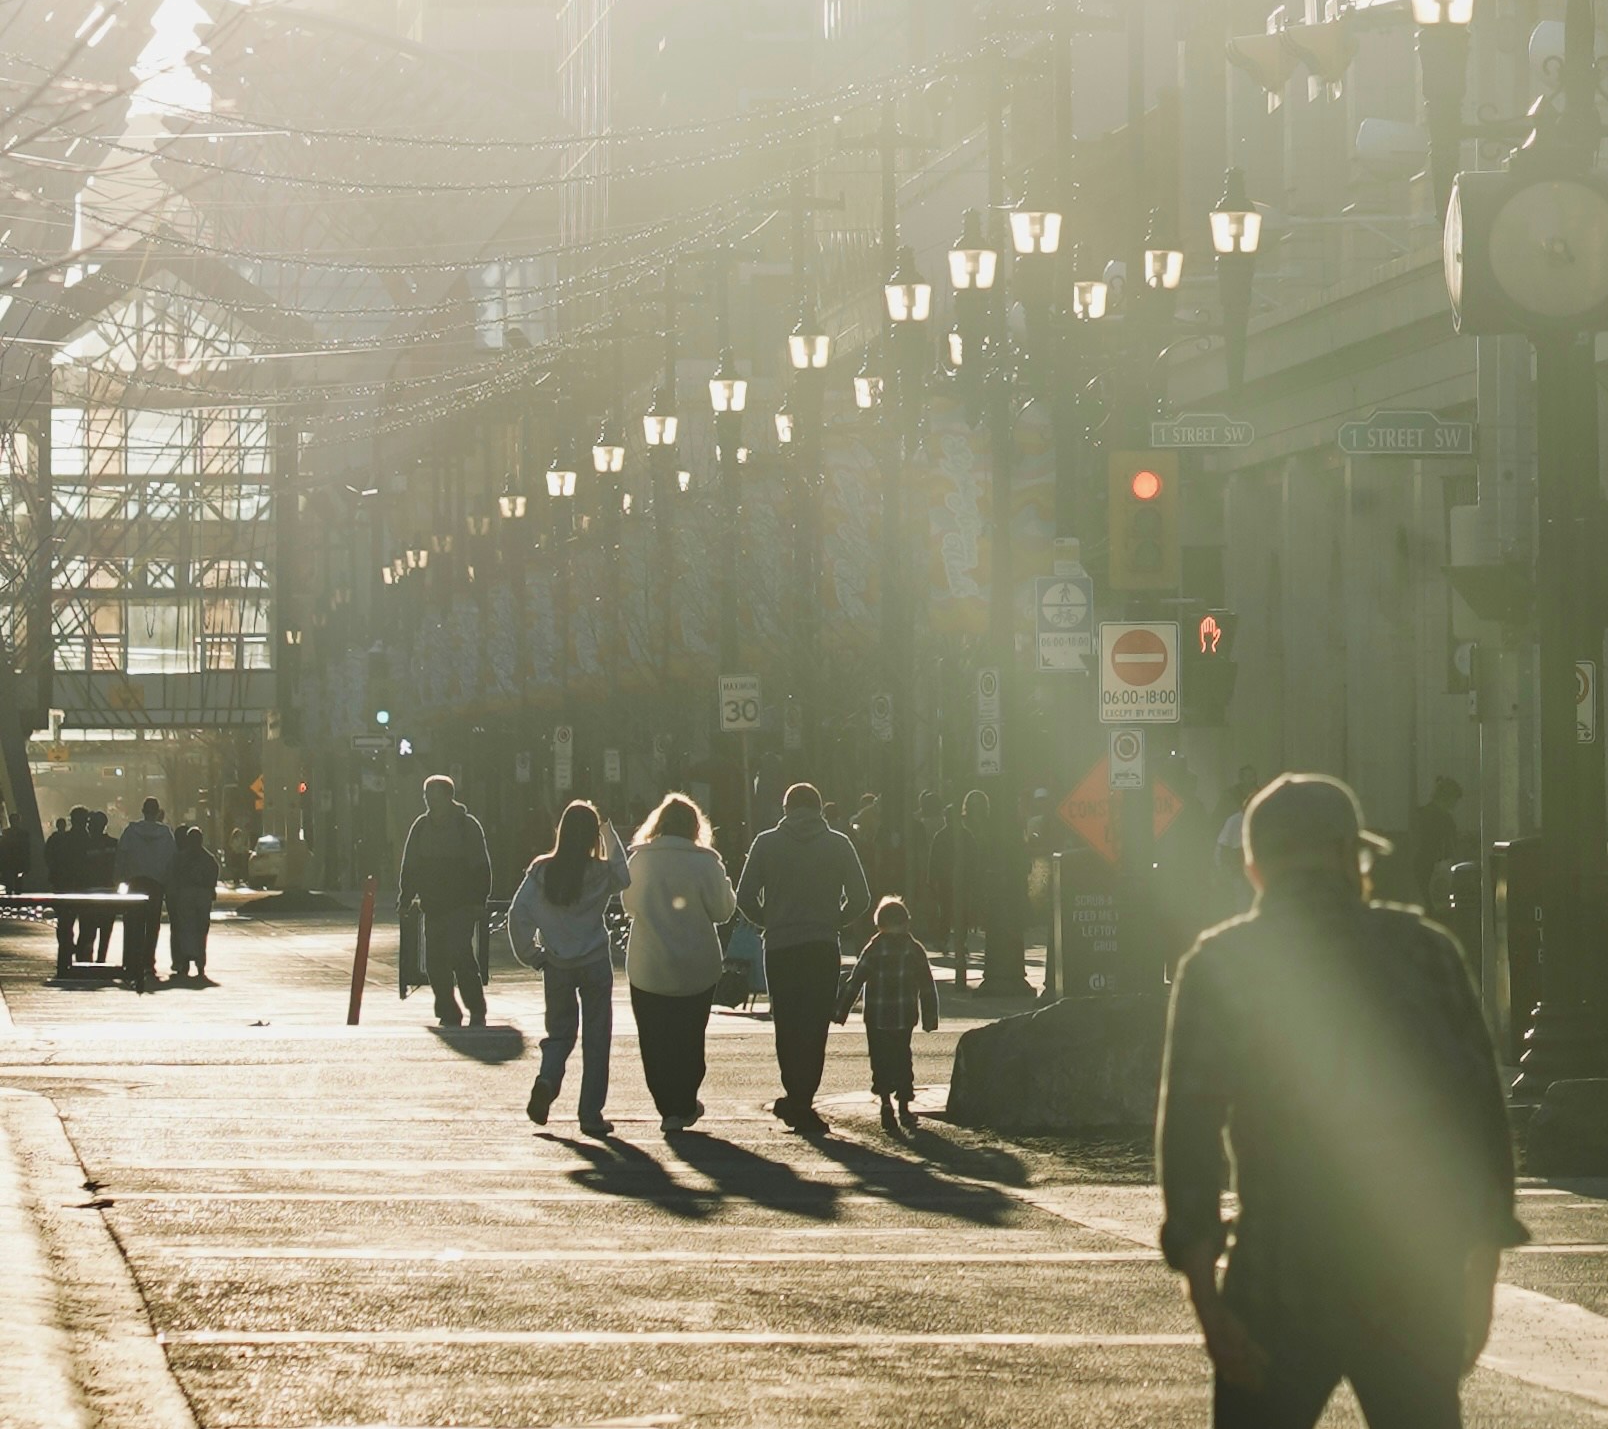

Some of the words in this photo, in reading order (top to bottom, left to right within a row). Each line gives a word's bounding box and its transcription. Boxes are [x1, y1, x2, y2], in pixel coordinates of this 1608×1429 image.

[1160, 428, 1166, 442] 1
[1172, 426, 1217, 443] STREET
[1223, 426, 1246, 441] SW
[1350, 430, 1358, 447] 1
[1367, 428, 1425, 448] STREET
[1435, 428, 1461, 447] SW
[723, 680, 757, 691] MAXIMUM
[724, 698, 759, 723] 30
[1072, 909, 1098, 922] FEED
[1081, 925, 1118, 937] LEFTOV
